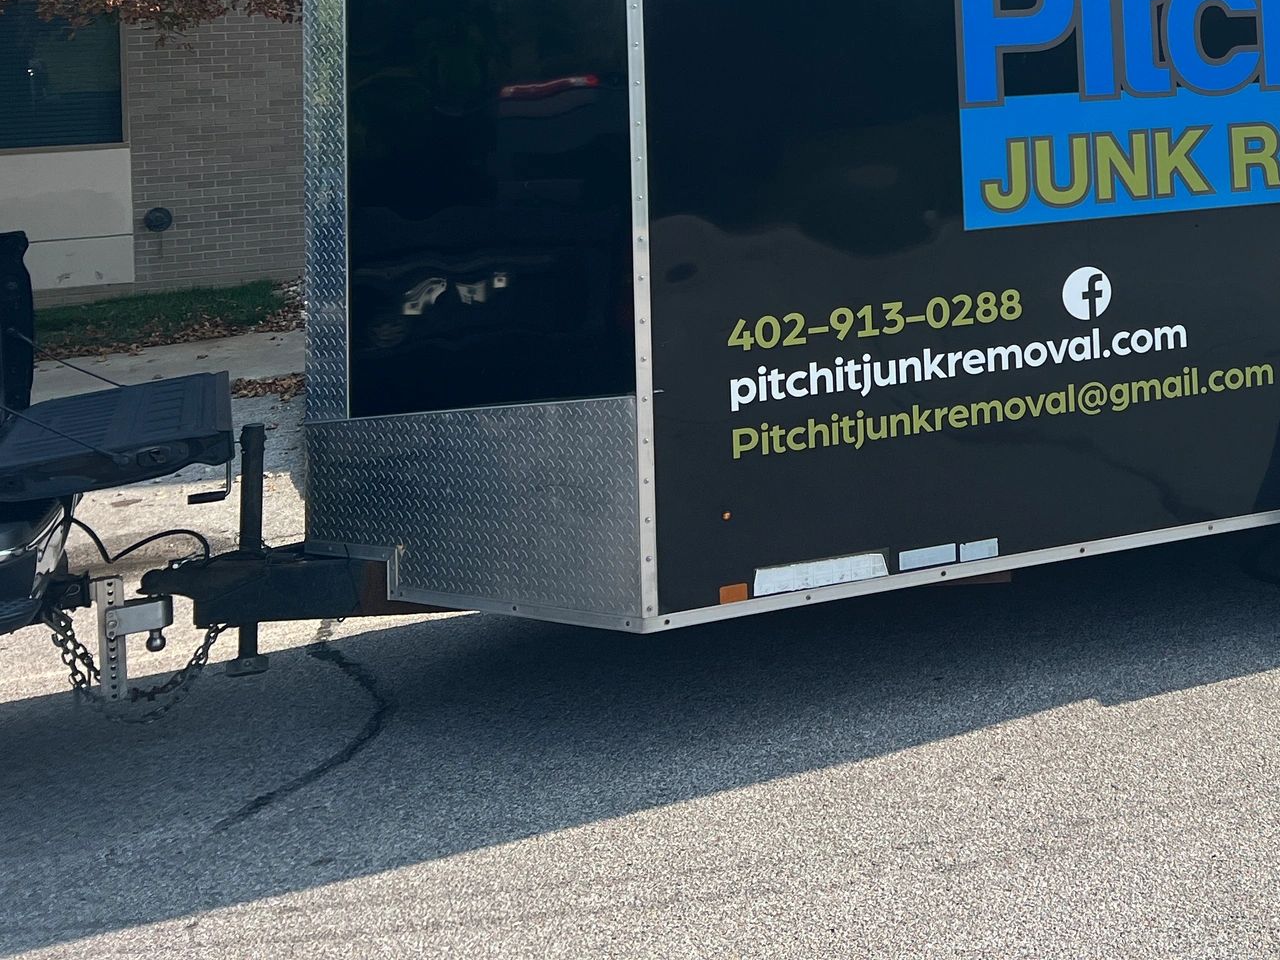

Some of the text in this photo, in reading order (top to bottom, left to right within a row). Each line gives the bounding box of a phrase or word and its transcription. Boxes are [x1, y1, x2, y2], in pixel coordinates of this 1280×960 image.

[981, 125, 1213, 211] JUNK
[727, 289, 1023, 351] 402-913-0288
[729, 324, 1188, 411] pitchitjunkremoval.com
[732, 361, 1274, 459] Pitchitjunkremoval@gmail.com
